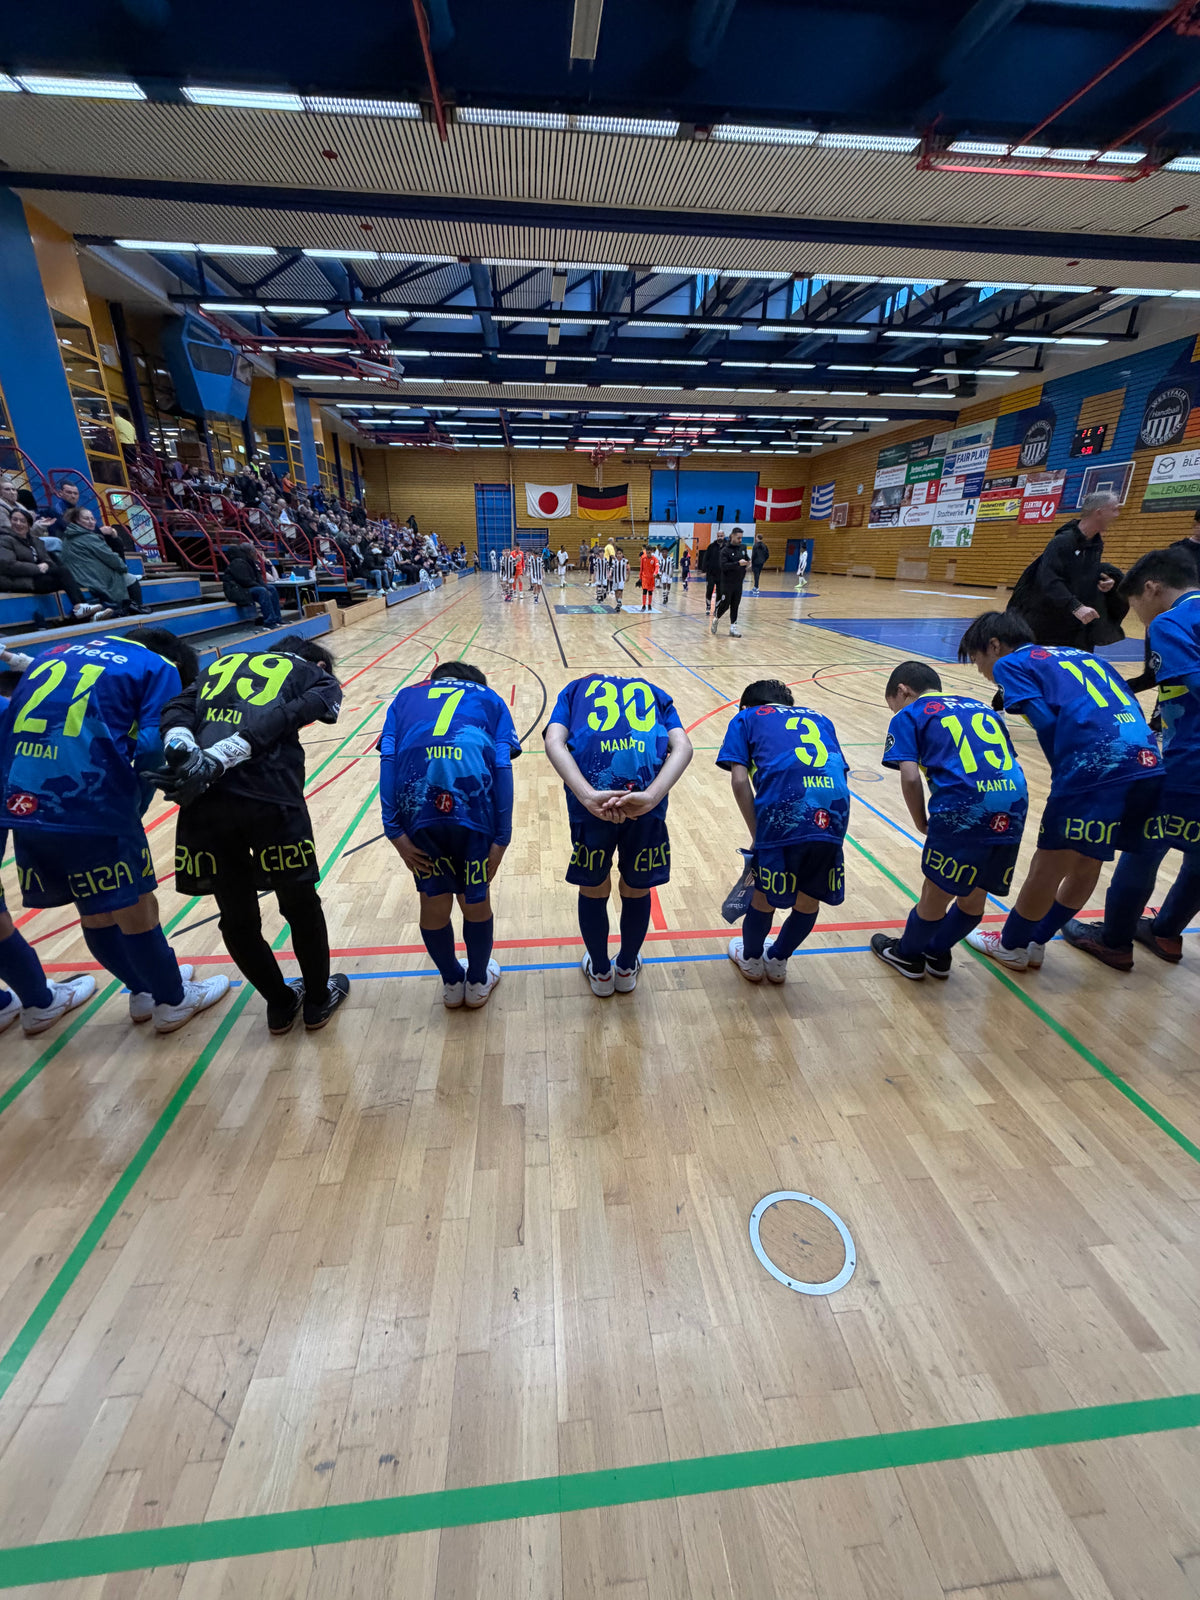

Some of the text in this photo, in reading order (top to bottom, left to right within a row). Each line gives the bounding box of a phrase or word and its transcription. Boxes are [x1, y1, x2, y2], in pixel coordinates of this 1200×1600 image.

[1151, 390, 1187, 408] WESTFALIA
[1152, 406, 1181, 417] Handball
[956, 448, 989, 463] FAIR PLAY!
[937, 510, 964, 518] Stadtwerke
[64, 644, 129, 665] Piece
[200, 652, 294, 706] 99
[1058, 658, 1132, 708] 11
[13, 659, 106, 737] 21
[584, 679, 656, 732] 30
[205, 707, 243, 725] KAZU
[427, 687, 465, 737] 7
[1114, 712, 1137, 724] YUU
[15, 741, 59, 760] YUDAI
[785, 716, 828, 768] 3
[940, 712, 1013, 774] 19
[425, 745, 463, 761] YUITO
[802, 775, 835, 790] IKKEI
[977, 779, 1017, 793] KANTA
